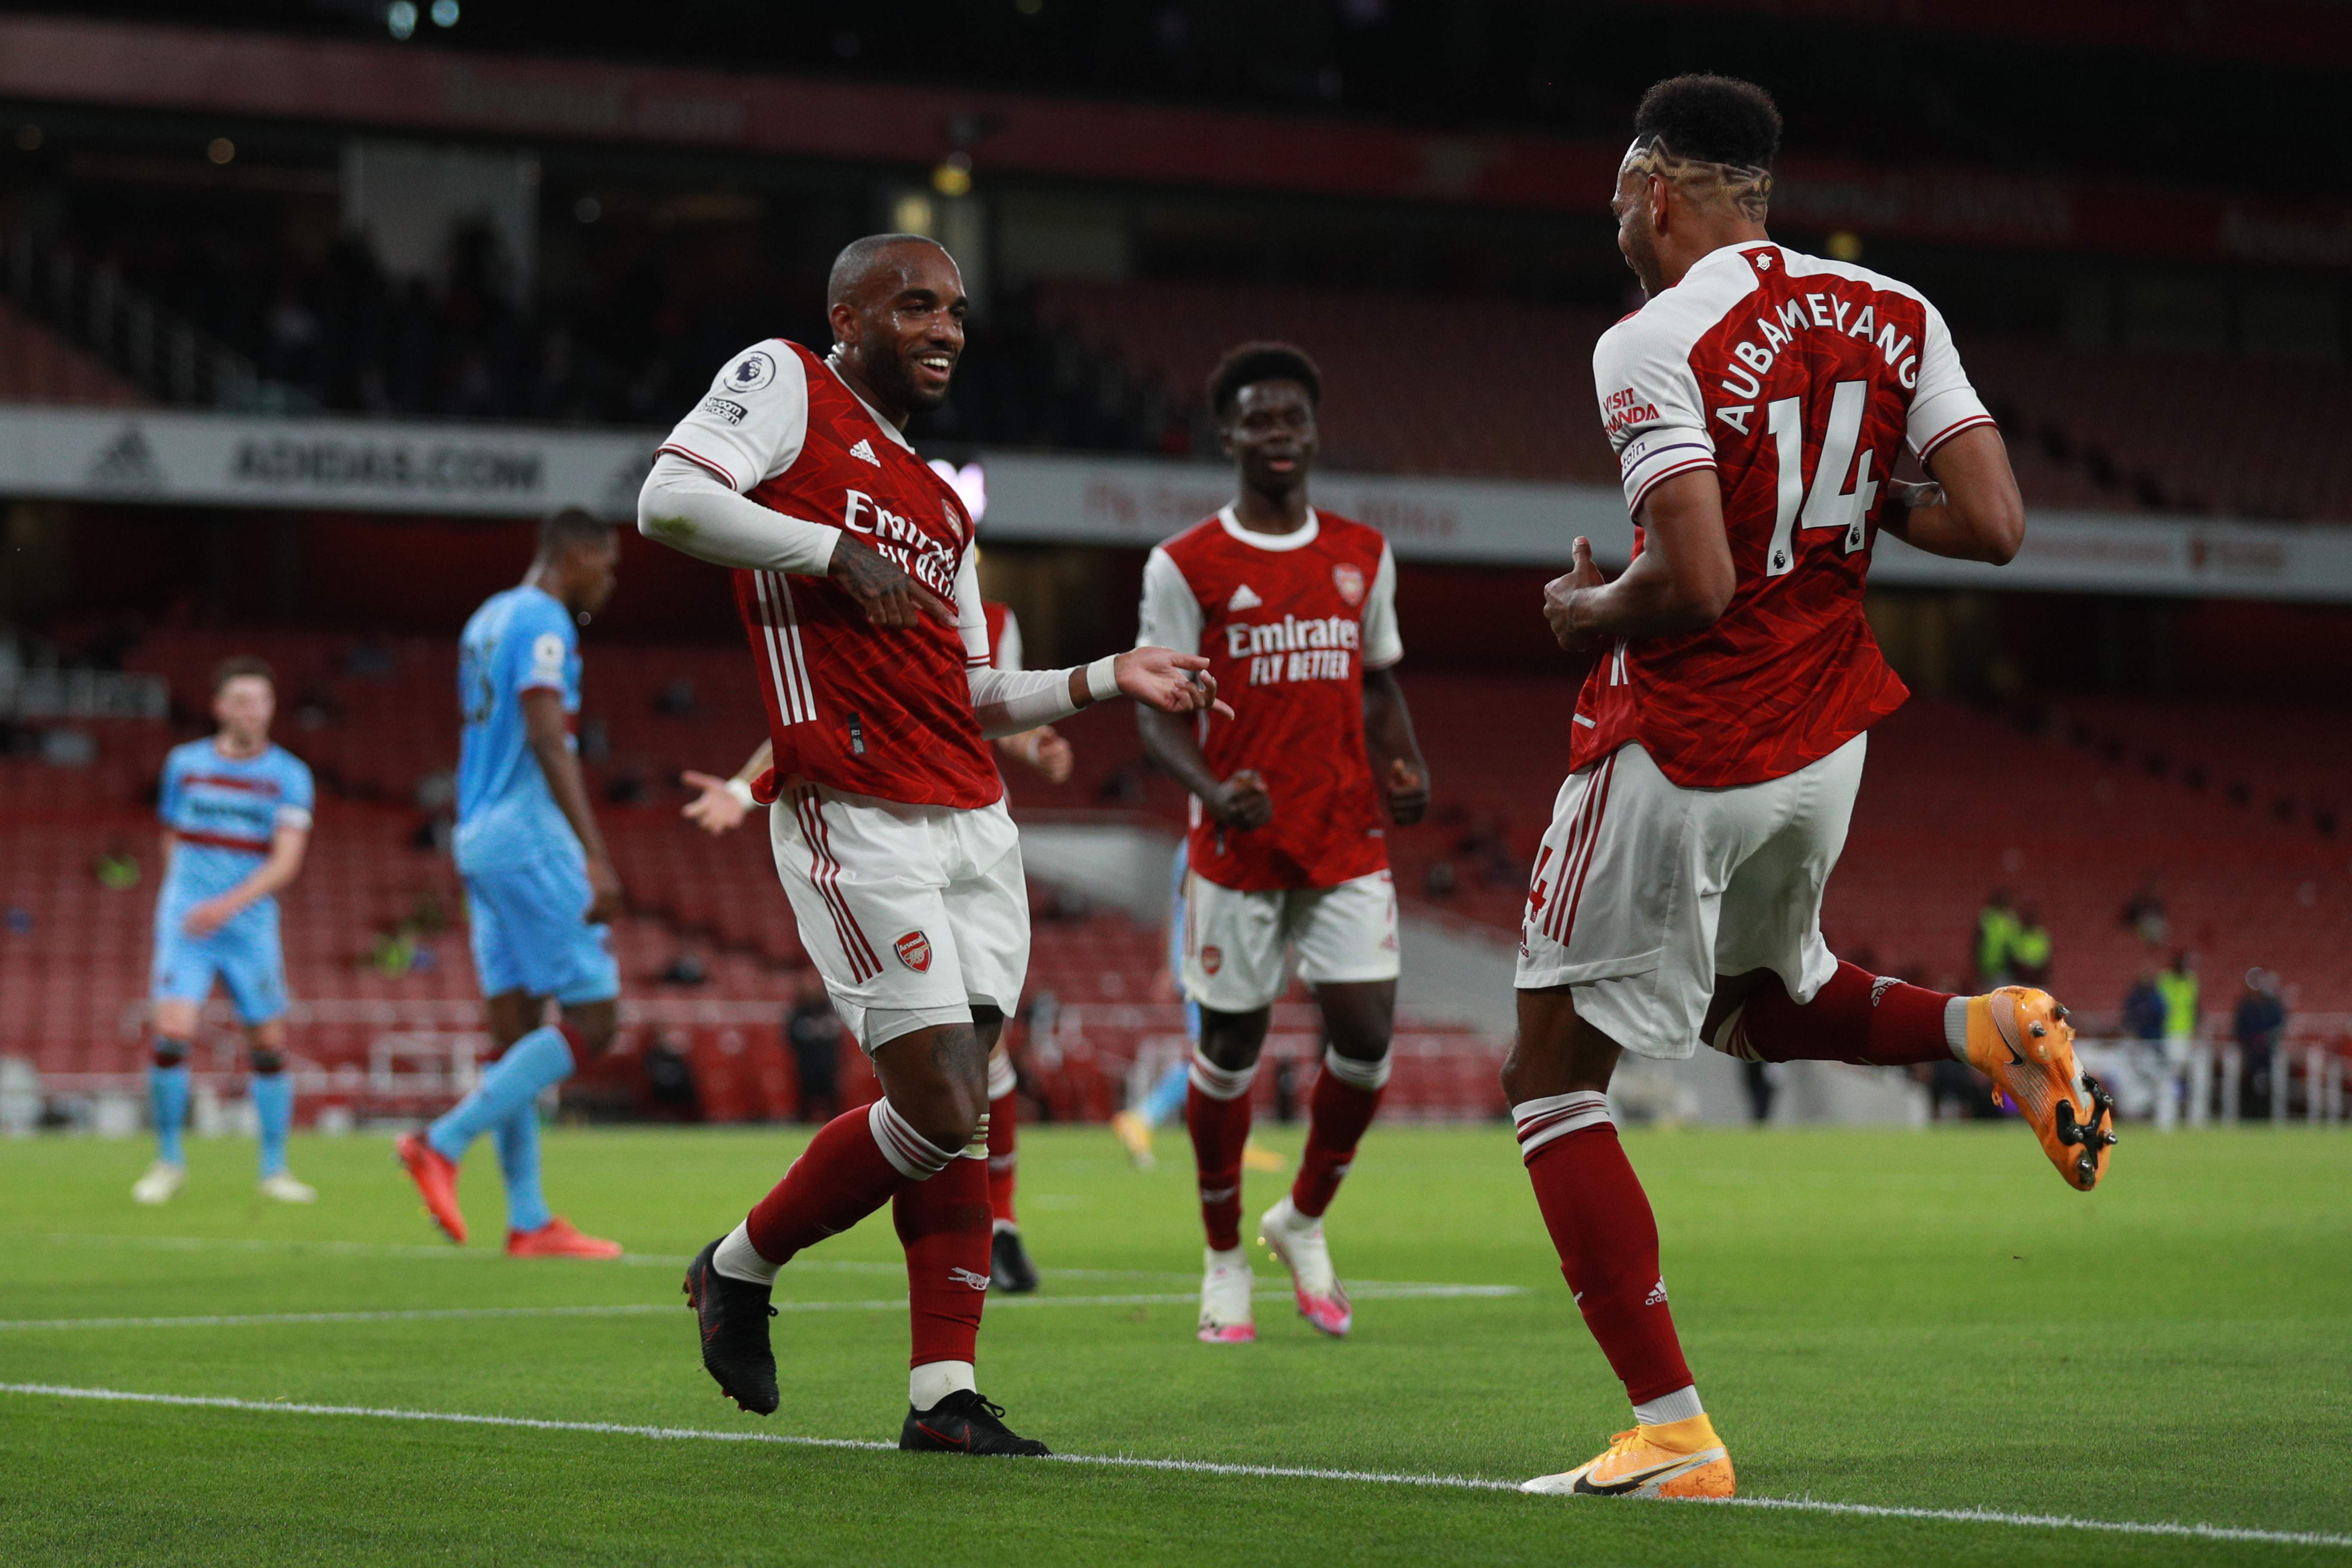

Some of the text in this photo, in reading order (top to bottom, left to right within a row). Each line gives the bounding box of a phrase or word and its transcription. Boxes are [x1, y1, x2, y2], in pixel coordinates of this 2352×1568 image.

[1715, 293, 1917, 435] AUBAMEYANG
[1603, 387, 1634, 415] VISIT
[1604, 403, 1660, 439] RWNDA
[849, 448, 882, 469] adidas
[1621, 441, 1646, 470] tain
[1766, 380, 1879, 577] 14
[845, 489, 956, 581] Emirat
[1250, 649, 1350, 686] FLY BETTER
